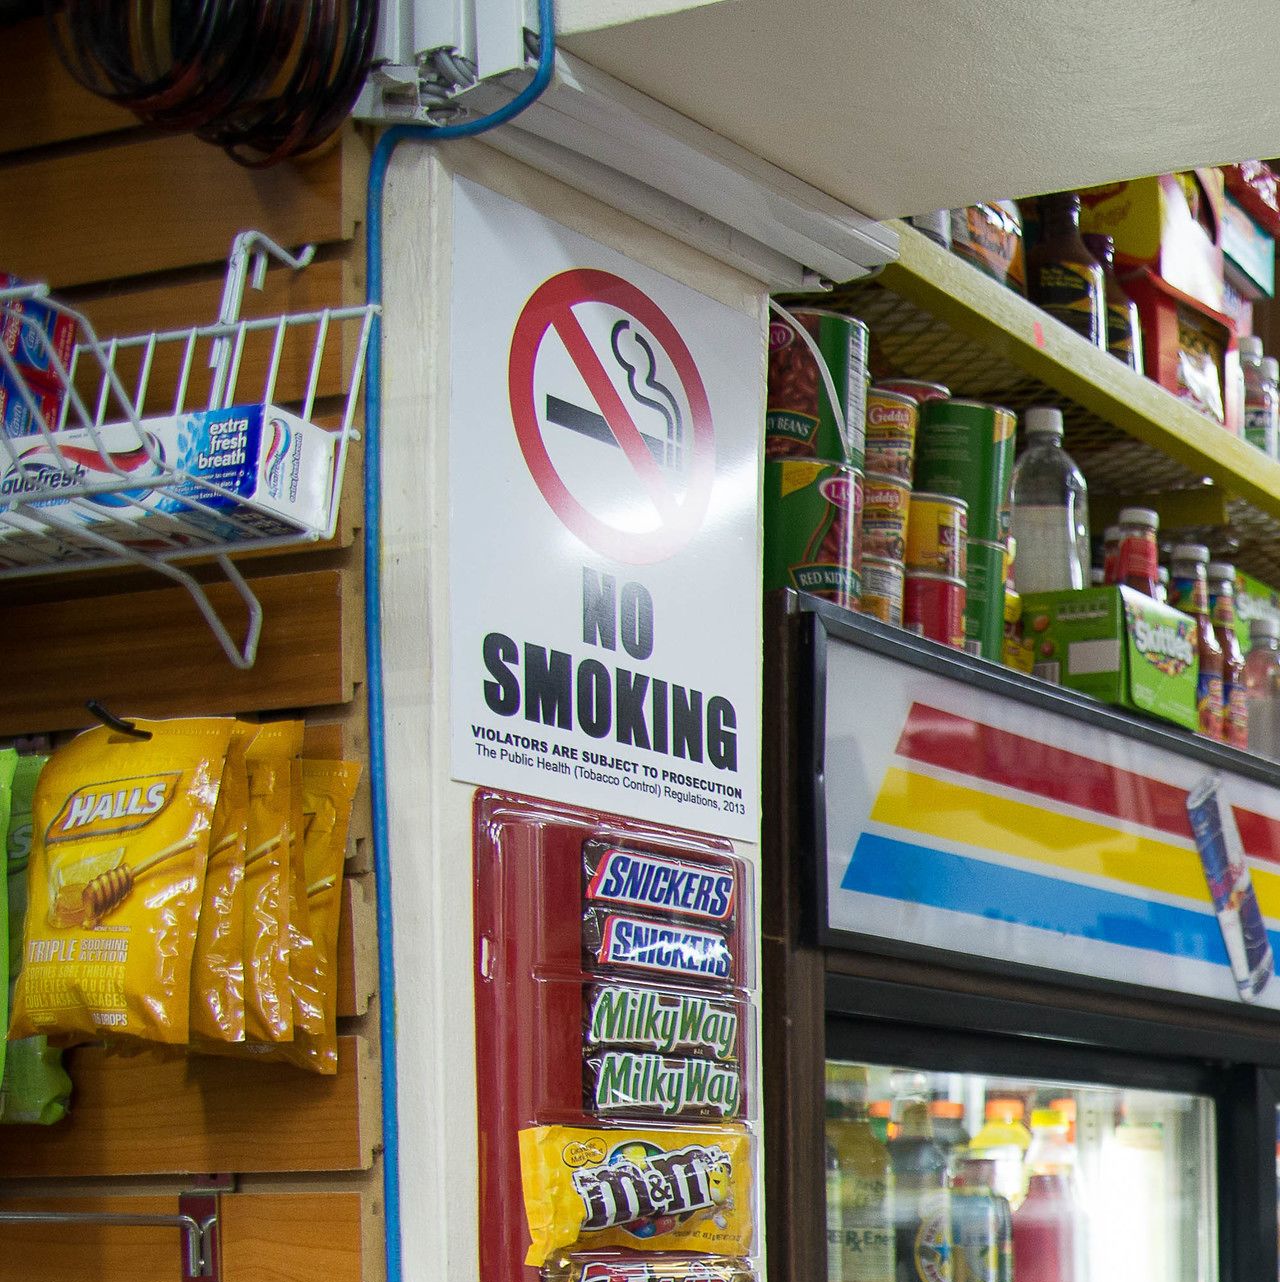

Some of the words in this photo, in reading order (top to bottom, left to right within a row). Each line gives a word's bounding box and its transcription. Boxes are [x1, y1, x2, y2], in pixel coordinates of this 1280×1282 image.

[209, 417, 249, 437] extra
[210, 433, 248, 457] fresh
[776, 417, 812, 439] BEANS
[1, 464, 88, 496] quafresh
[198, 450, 246, 471] breath
[800, 571, 823, 587] RED
[581, 566, 654, 661] NO
[481, 631, 739, 773] SMOKING
[471, 724, 549, 754] VIOLATORS
[552, 744, 579, 761] ARE
[582, 751, 639, 775] SUBJECT
[642, 764, 659, 779] TO
[662, 769, 743, 800] PROSECUTION
[475, 742, 498, 759] The
[500, 748, 534, 769] Public
[536, 757, 571, 776] Health
[574, 765, 620, 787] (Tobacco
[623, 776, 662, 798] Control)
[664, 786, 721, 812] Regulations,
[723, 800, 746, 816] 2013
[62, 782, 168, 831] HALLS
[601, 855, 734, 918] SNICKERS
[28, 939, 78, 963] TRIPLE
[80, 938, 129, 952] SOOTHING
[78, 950, 128, 963] ACTION
[612, 921, 731, 979] SNICKERS
[82, 964, 127, 979] THROATS
[593, 990, 681, 1051] Milky
[679, 999, 738, 1060] Way
[598, 1055, 687, 1115] Milky
[685, 1061, 740, 1117] Way
